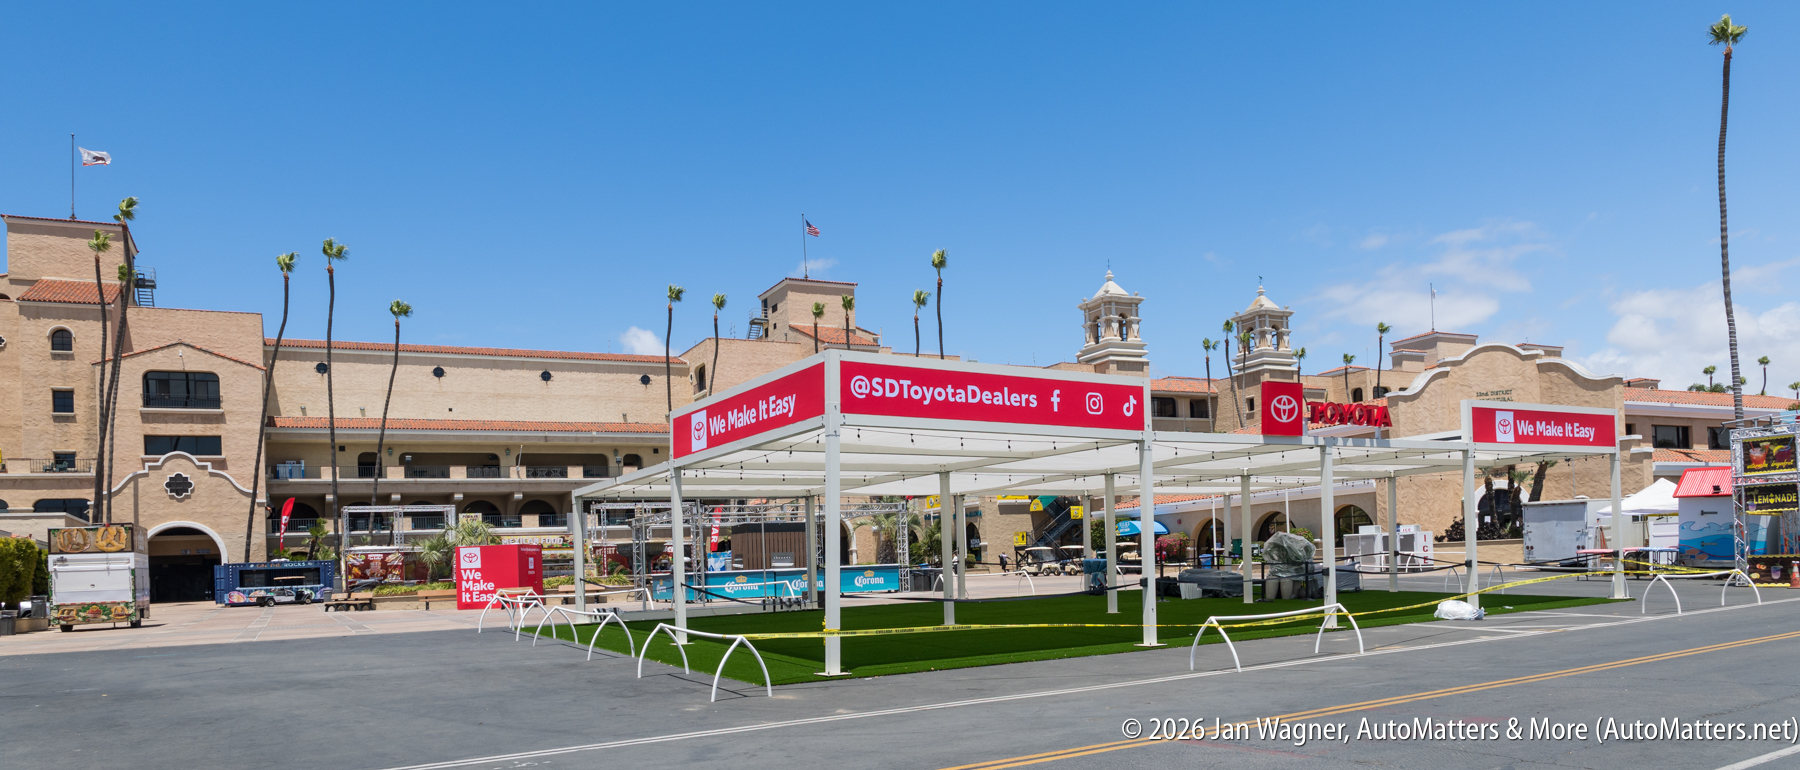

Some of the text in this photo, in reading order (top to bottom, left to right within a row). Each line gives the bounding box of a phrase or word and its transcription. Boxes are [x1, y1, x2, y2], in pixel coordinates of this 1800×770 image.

[850, 375, 1038, 408] @SDToyotaDealers
[709, 394, 796, 437] We Make It Easy
[1307, 401, 1393, 427] TOYOTA
[1516, 419, 1595, 442] We Make It Easy
[1753, 493, 1797, 504] LEMONADE
[501, 537, 539, 545] MEXICAN
[461, 569, 481, 580] We
[462, 580, 495, 591] Make
[855, 576, 884, 588] Corona
[462, 592, 471, 603] It
